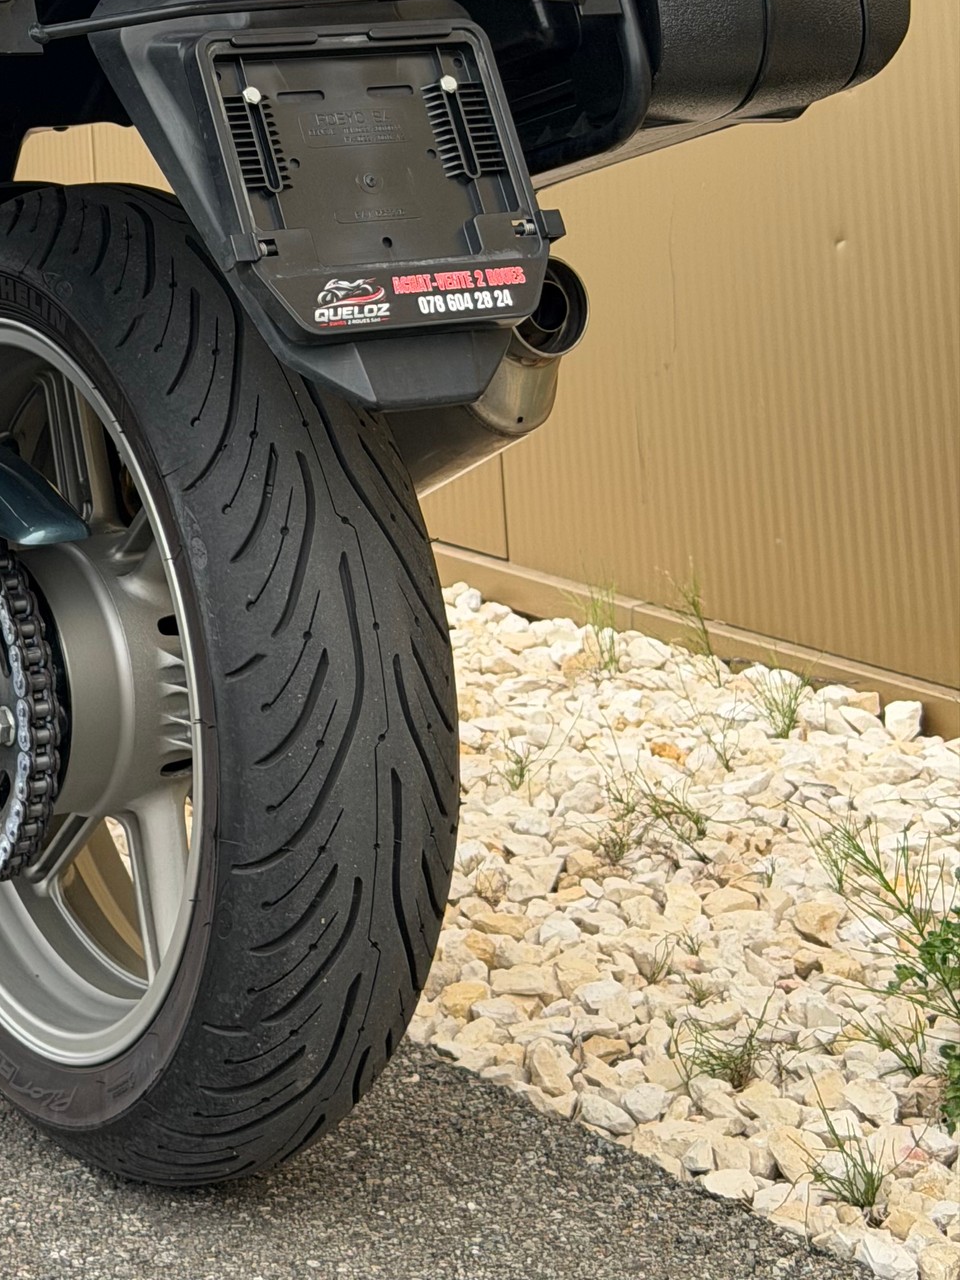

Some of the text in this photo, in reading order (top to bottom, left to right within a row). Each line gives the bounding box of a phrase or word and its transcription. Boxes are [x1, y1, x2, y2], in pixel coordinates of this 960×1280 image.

[474, 270, 486, 288] 2
[418, 289, 513, 314] 078 604 28 24
[314, 303, 390, 322] QUELOZ
